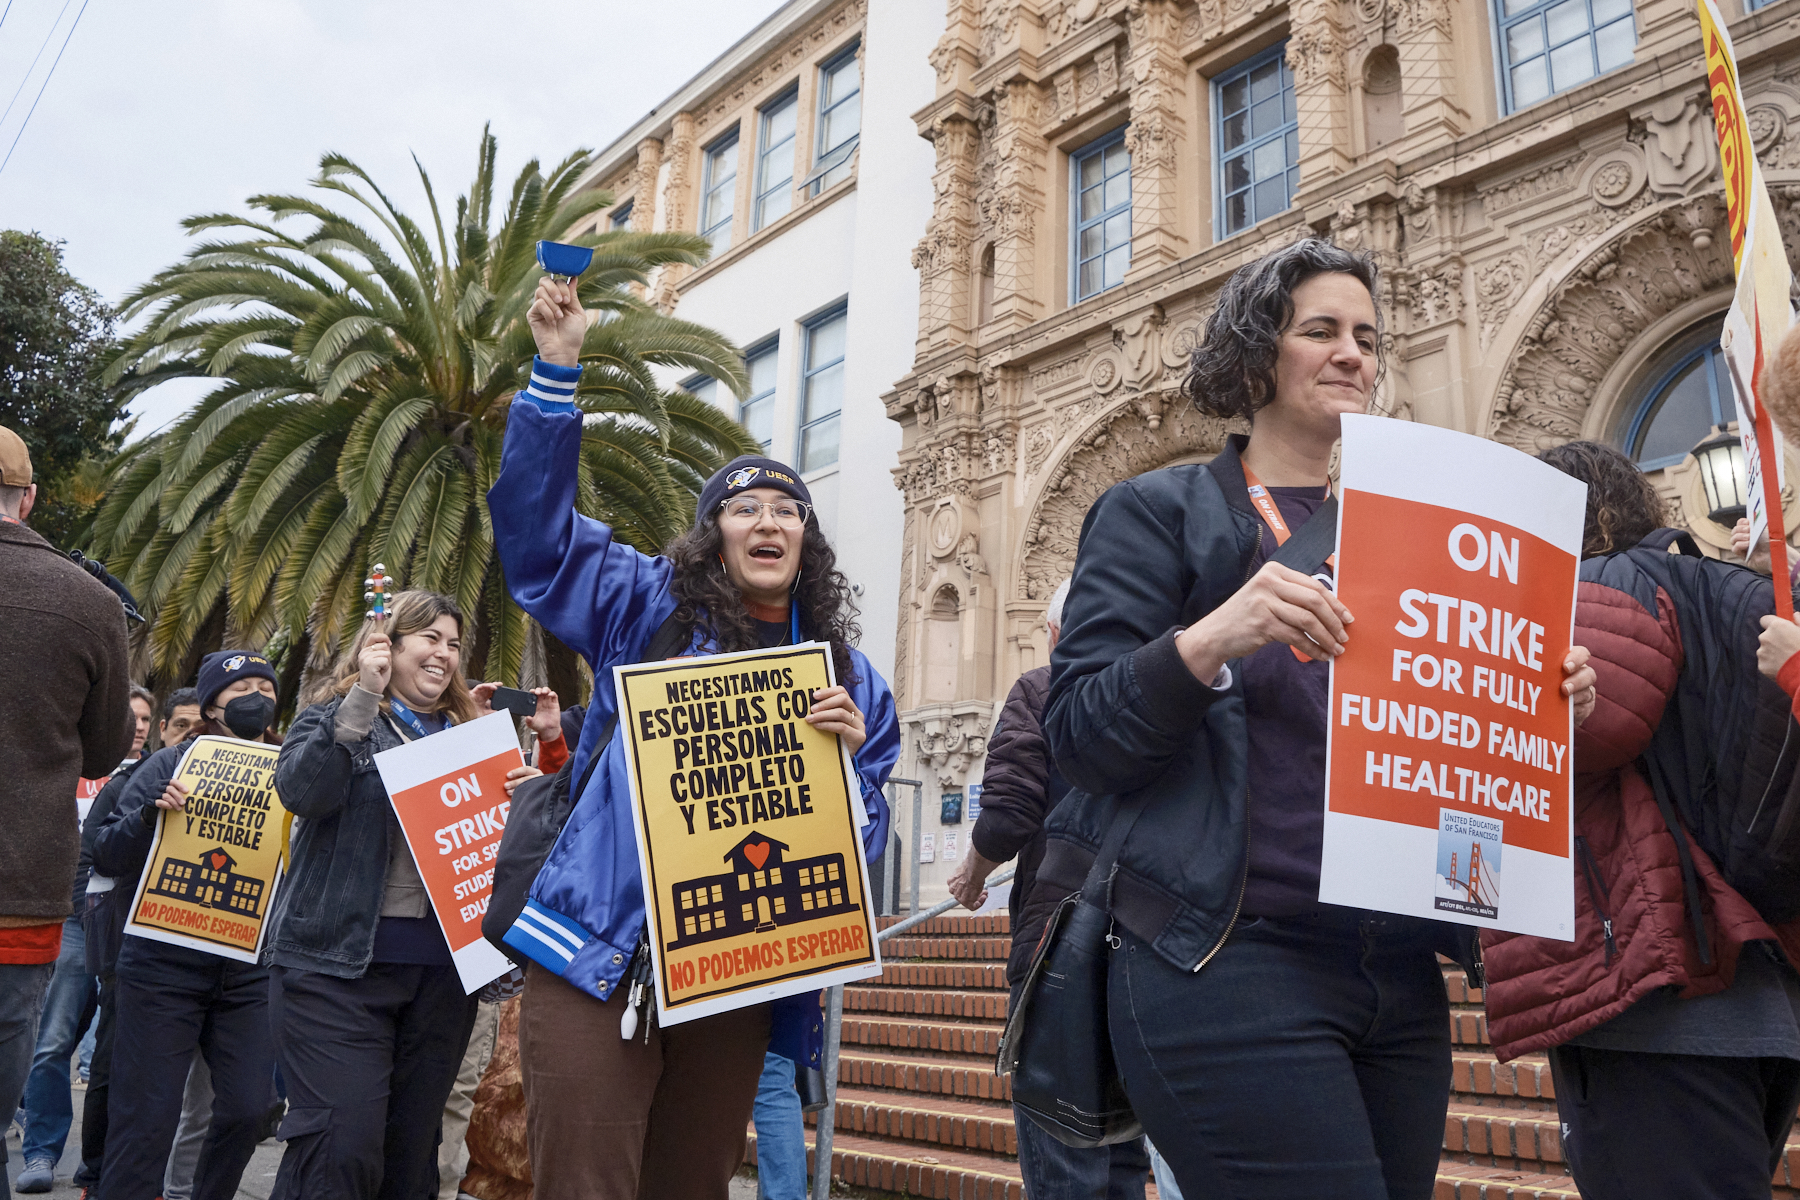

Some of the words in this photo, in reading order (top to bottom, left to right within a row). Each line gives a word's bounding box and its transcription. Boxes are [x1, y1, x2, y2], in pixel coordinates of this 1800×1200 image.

[1258, 498, 1271, 510] ON
[1264, 509, 1284, 530] STRIKE
[1447, 522, 1520, 585] ON
[1394, 588, 1544, 672] STRIKE
[665, 667, 794, 704] NECESITAMOS
[1392, 648, 1464, 695] FOR
[1472, 664, 1542, 716] FULLY
[638, 695, 767, 742] ESCUELAS
[1340, 692, 1481, 749] FUNDED
[1487, 721, 1567, 774] FAMILY
[673, 722, 804, 770] PERSONAL
[186, 759, 263, 787] ESCUELAS
[440, 772, 482, 808] ON
[670, 753, 805, 804] COMPLETO
[1365, 750, 1551, 822] HEALTHCARE
[184, 796, 266, 829] COMPLETO
[192, 778, 272, 811] PERSONAL
[679, 803, 695, 835] Y
[706, 784, 814, 831] ESTABLE
[186, 815, 195, 834] Y
[198, 818, 263, 851] ESTABLE
[1444, 812, 1468, 825] UNITED
[1468, 817, 1500, 832] EDUCATORS
[1454, 824, 1467, 835] SAN
[1468, 827, 1499, 841] FRANCISCO
[452, 851, 483, 876] FOR
[453, 867, 496, 900] STUDE
[139, 900, 158, 919] NO
[156, 904, 210, 931] PODEMOS
[209, 917, 257, 943] ESPERAR
[669, 960, 696, 991] NO
[697, 939, 785, 985] PODEMOS
[786, 924, 865, 963] ESPERAR
